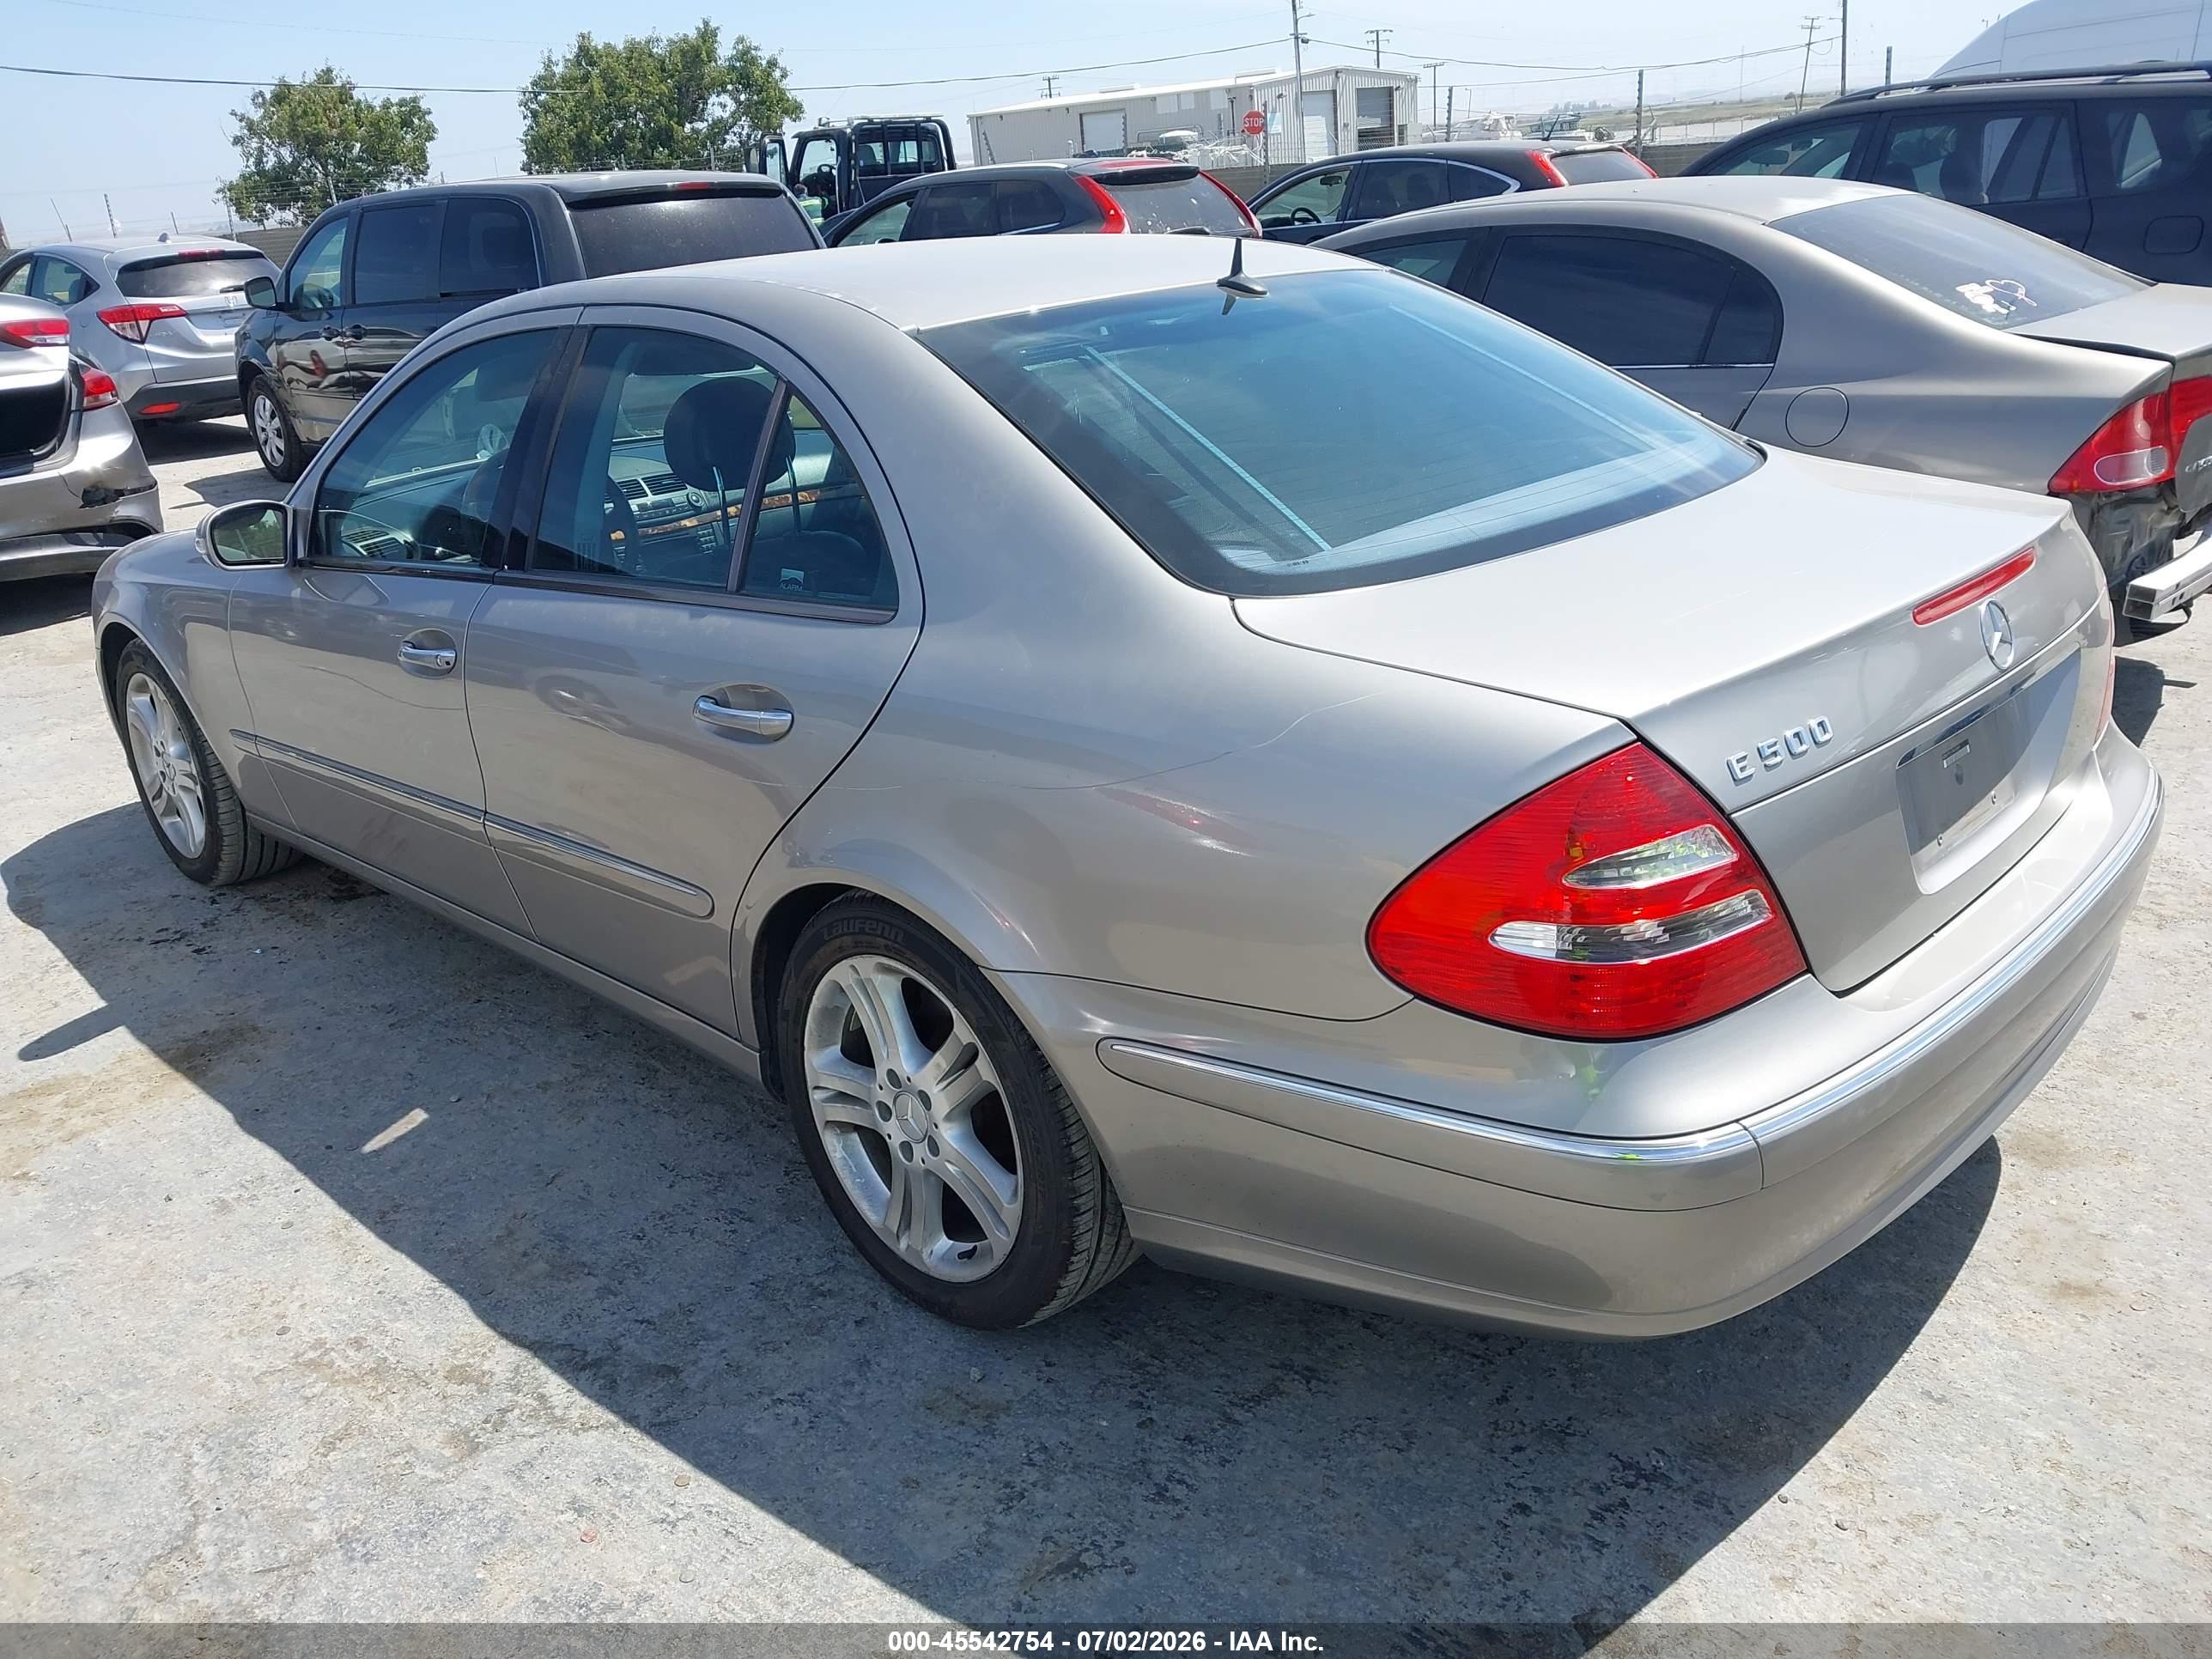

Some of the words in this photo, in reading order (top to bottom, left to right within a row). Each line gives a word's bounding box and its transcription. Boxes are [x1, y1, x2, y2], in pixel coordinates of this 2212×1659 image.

[1244, 117, 1264, 127] STOP
[1726, 751, 1756, 783] E
[1757, 715, 1834, 769] 500
